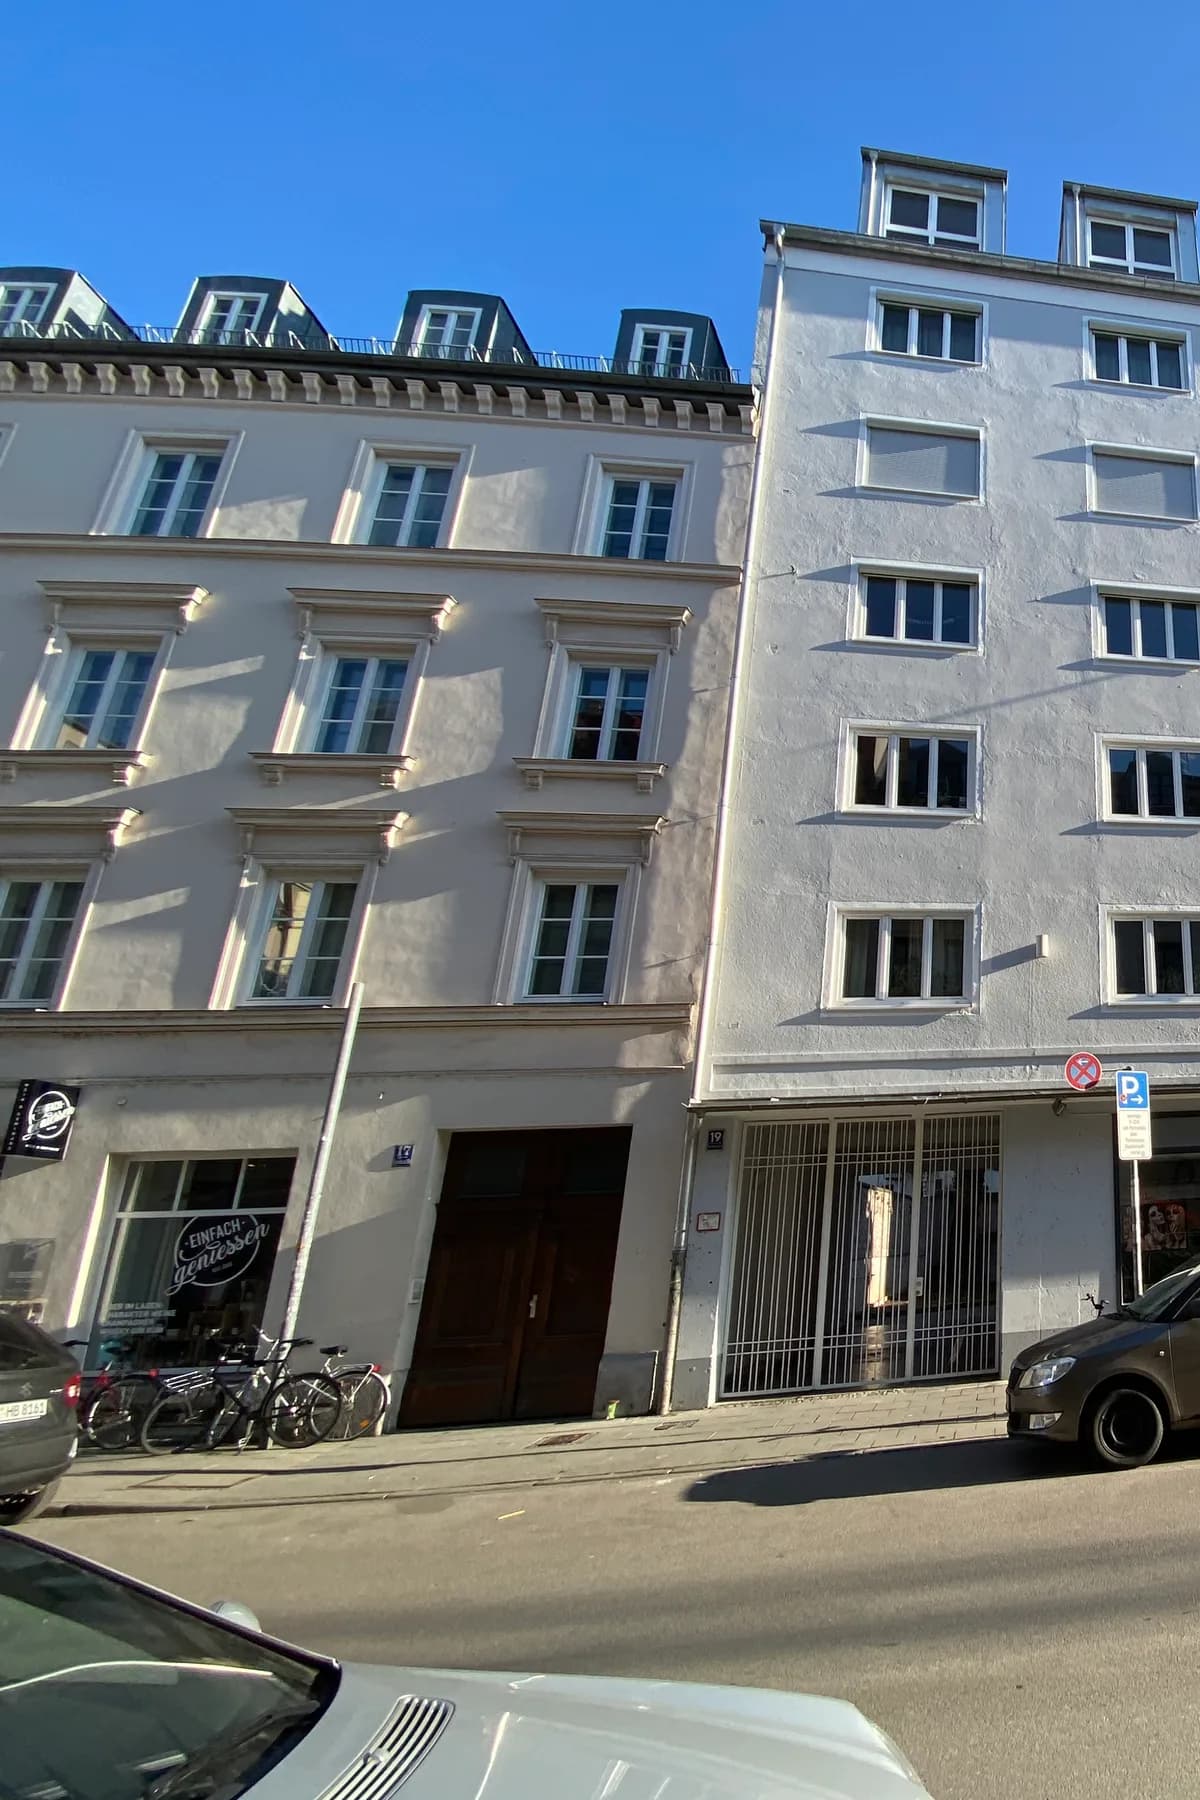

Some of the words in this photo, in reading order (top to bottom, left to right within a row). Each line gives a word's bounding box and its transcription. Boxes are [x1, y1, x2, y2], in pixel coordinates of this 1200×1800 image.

[1121, 1076, 1139, 1104] P
[397, 1145, 412, 1157] 17
[710, 1132, 722, 1143] 19
[189, 1218, 241, 1249] EINFACH
[164, 1223, 270, 1297] geniessen
